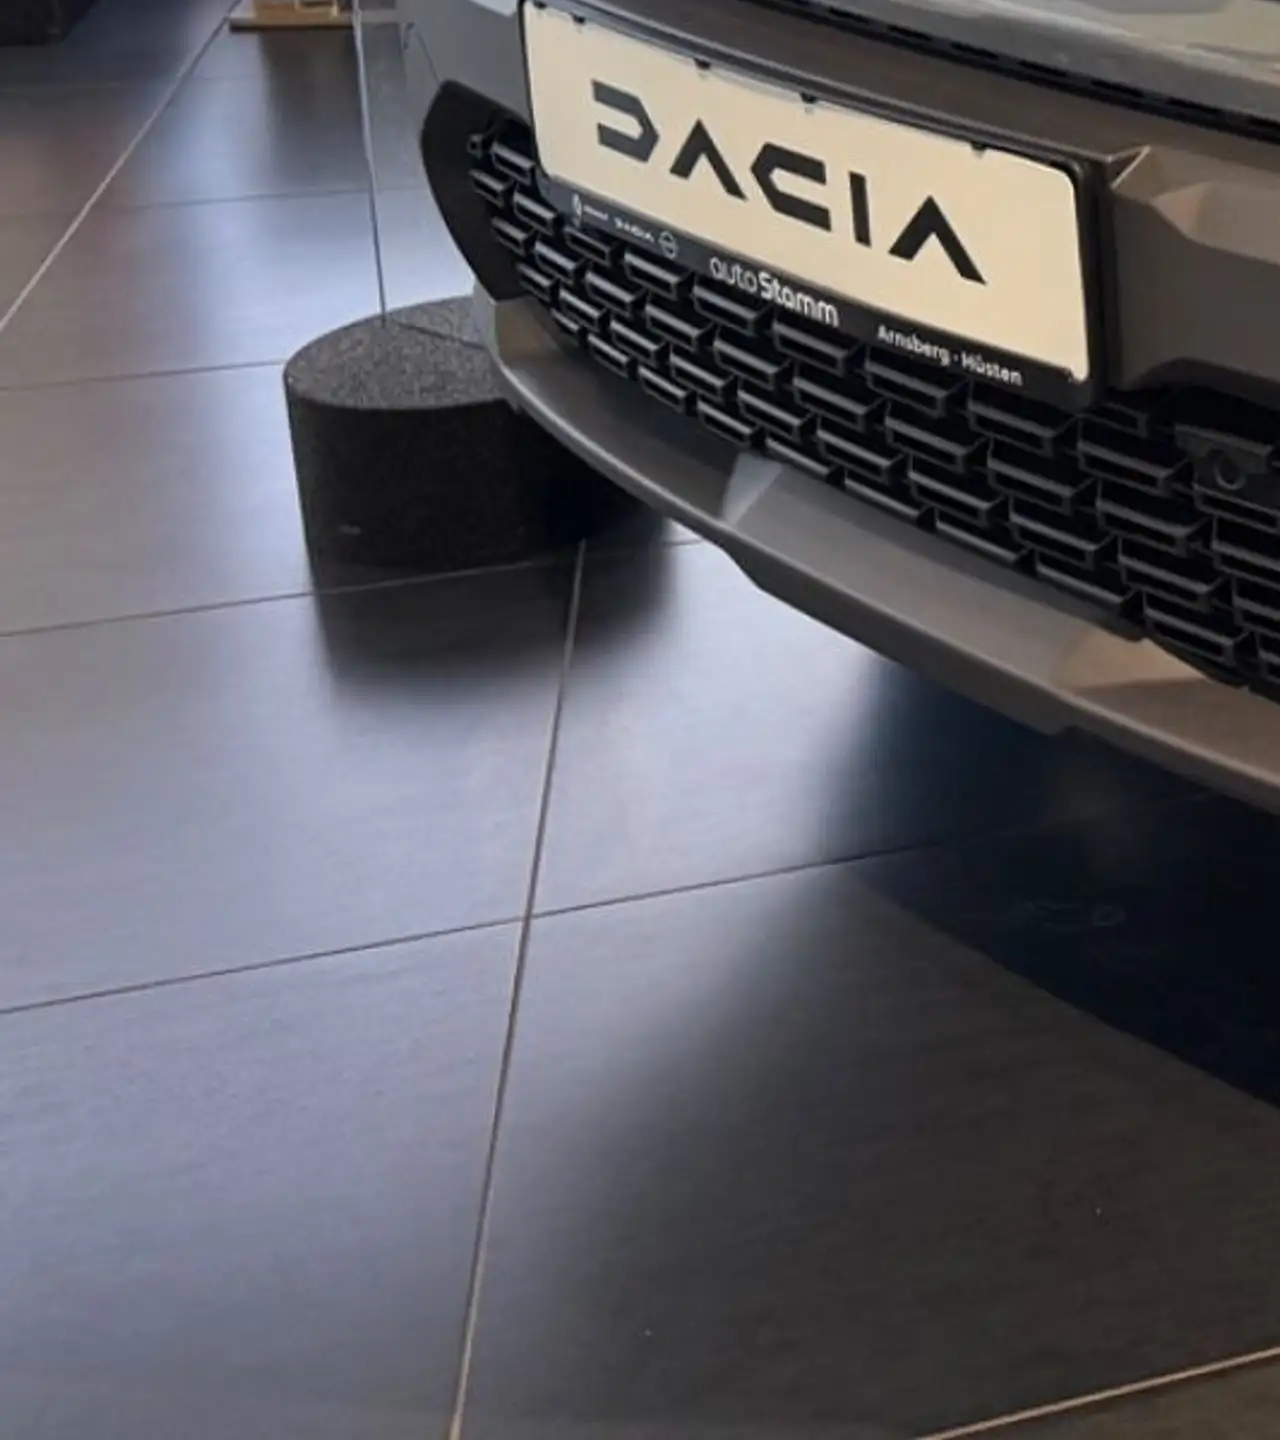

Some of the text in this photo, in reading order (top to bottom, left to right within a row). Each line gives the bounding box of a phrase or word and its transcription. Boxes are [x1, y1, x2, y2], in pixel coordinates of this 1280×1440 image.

[591, 78, 987, 285] DACIA
[709, 257, 839, 328] autoStamm
[876, 324, 1024, 387] Arnsberg Hüsten
